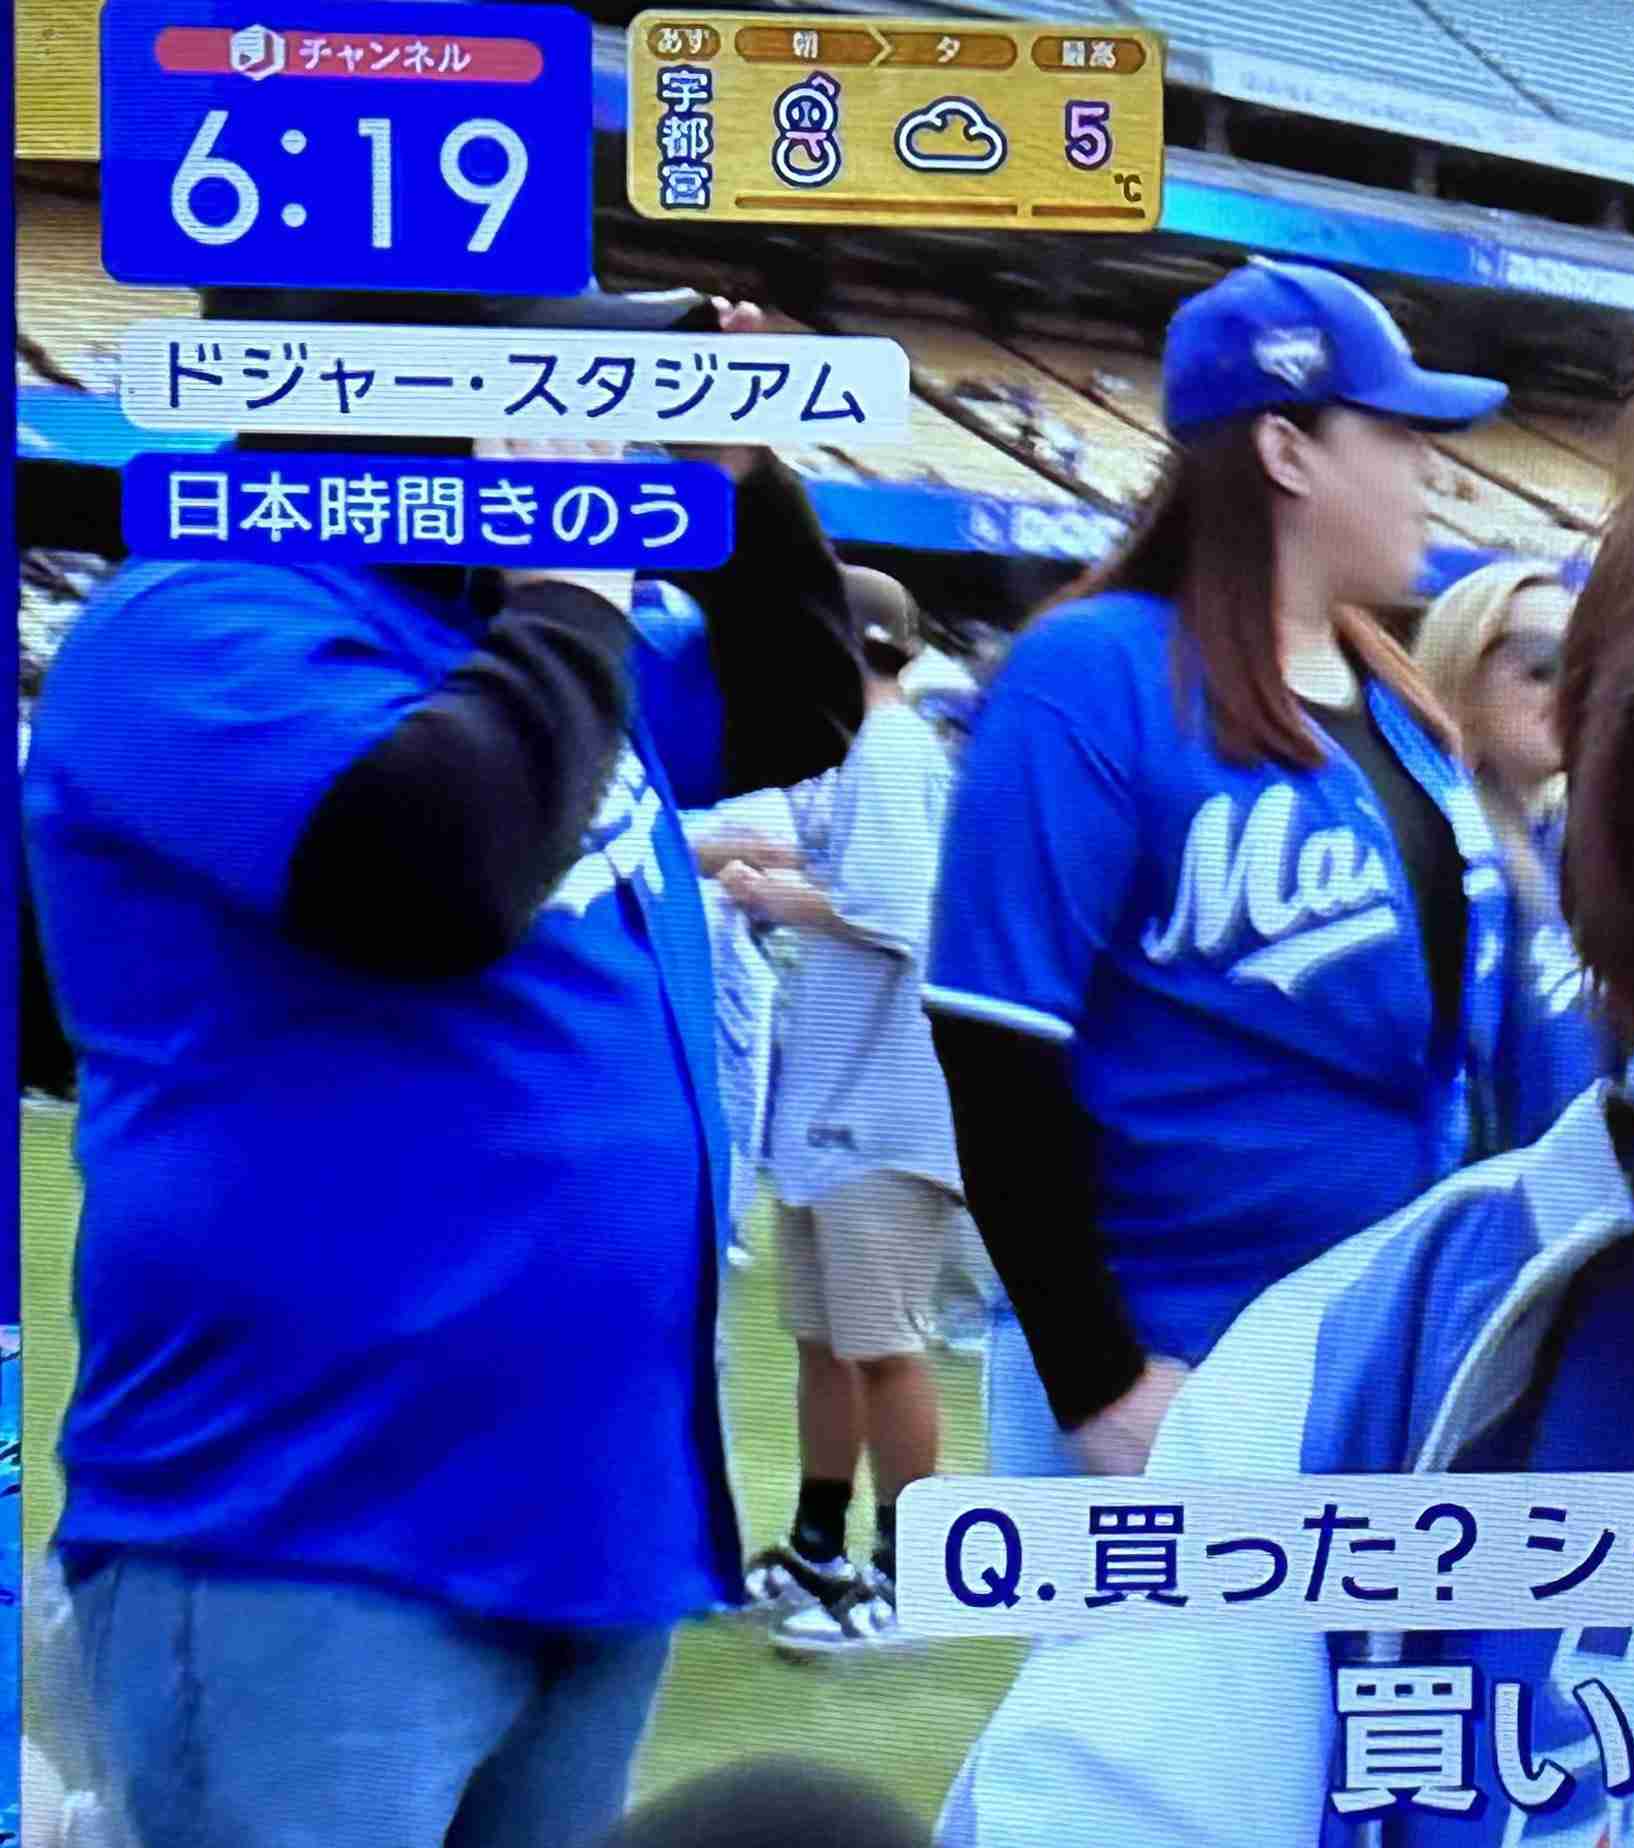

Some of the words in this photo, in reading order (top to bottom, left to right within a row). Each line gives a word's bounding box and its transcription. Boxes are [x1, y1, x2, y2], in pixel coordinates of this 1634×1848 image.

[1067, 101, 1111, 169] 5
[170, 109, 529, 253] 6:19
[166, 341, 866, 424] ドジャー・スタジアム
[168, 470, 690, 548] 日本時間きのう
